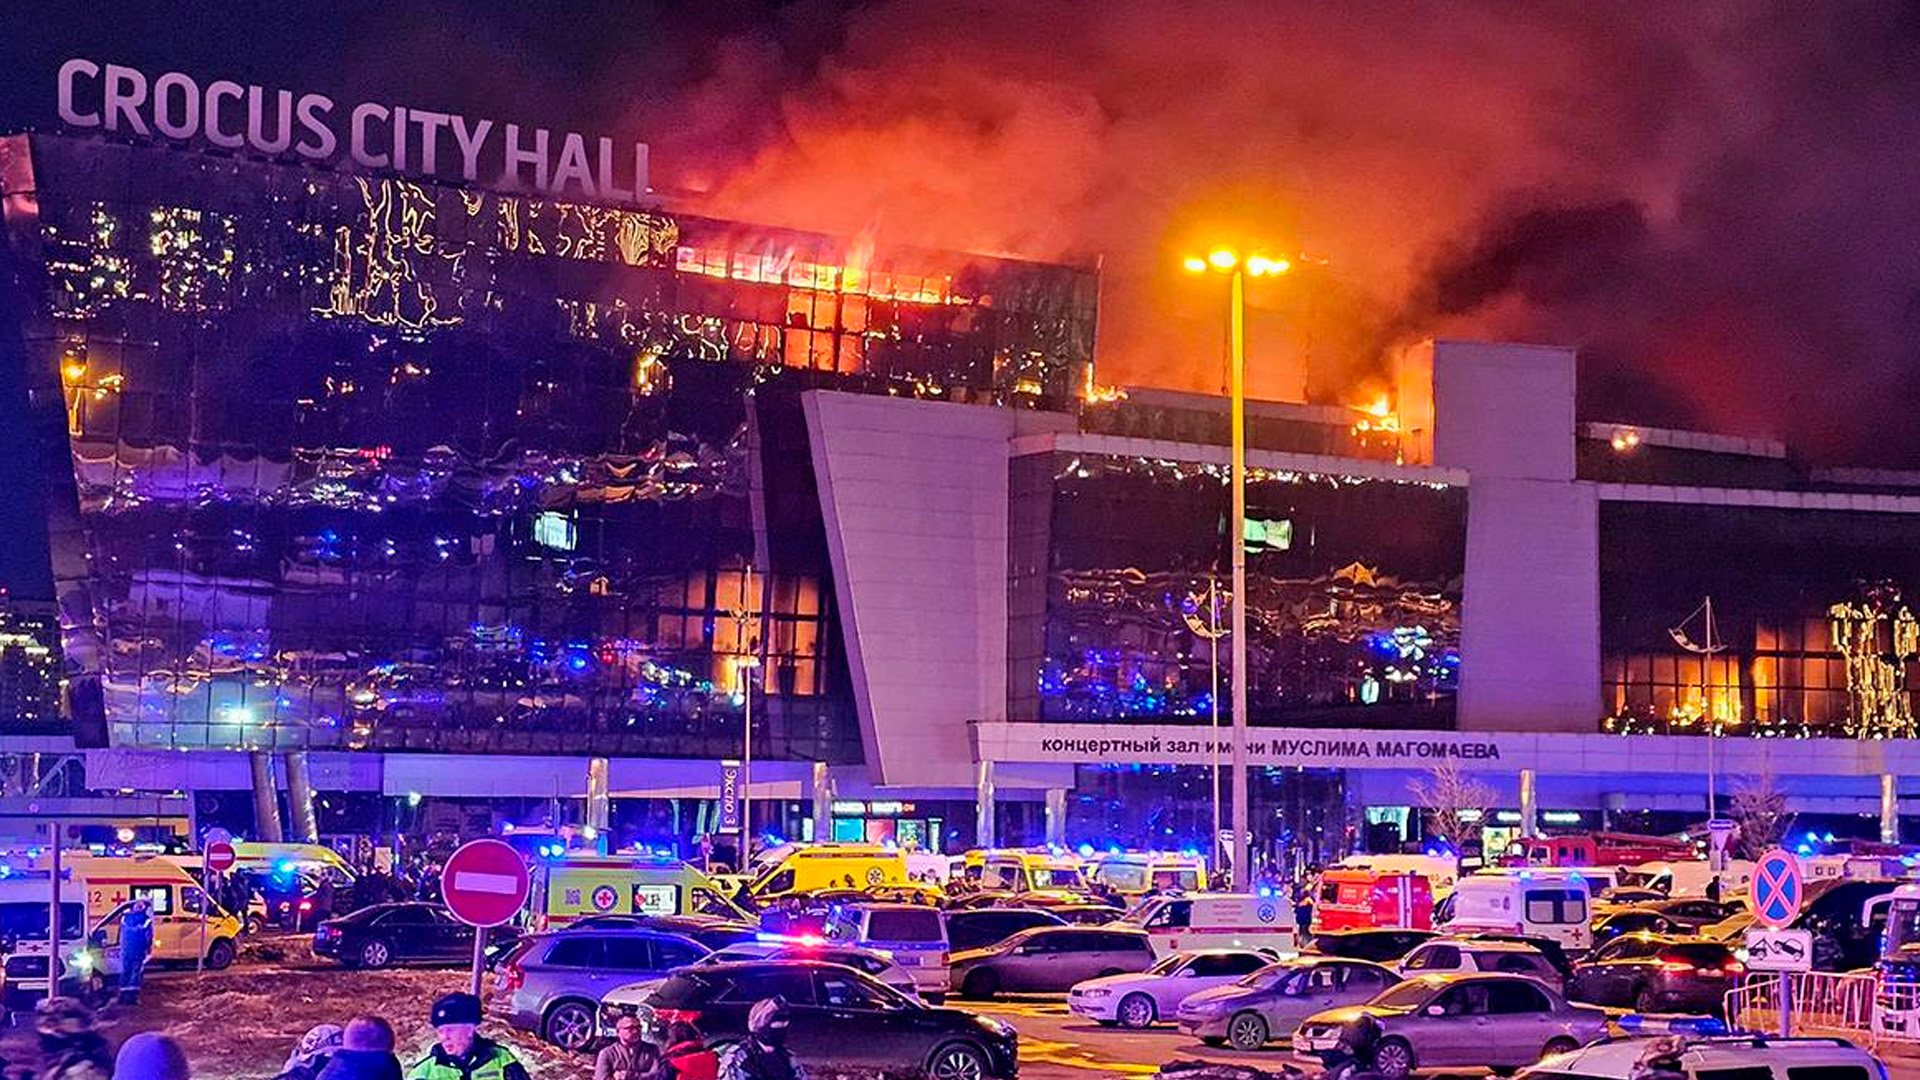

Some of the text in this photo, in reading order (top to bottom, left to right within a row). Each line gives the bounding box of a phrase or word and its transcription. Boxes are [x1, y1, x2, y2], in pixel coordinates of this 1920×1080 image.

[58, 58, 658, 204] CROCUS CITY HALL
[1042, 736, 1500, 759] концертный зал имни МУСЛИМА МАГОМАЕВА
